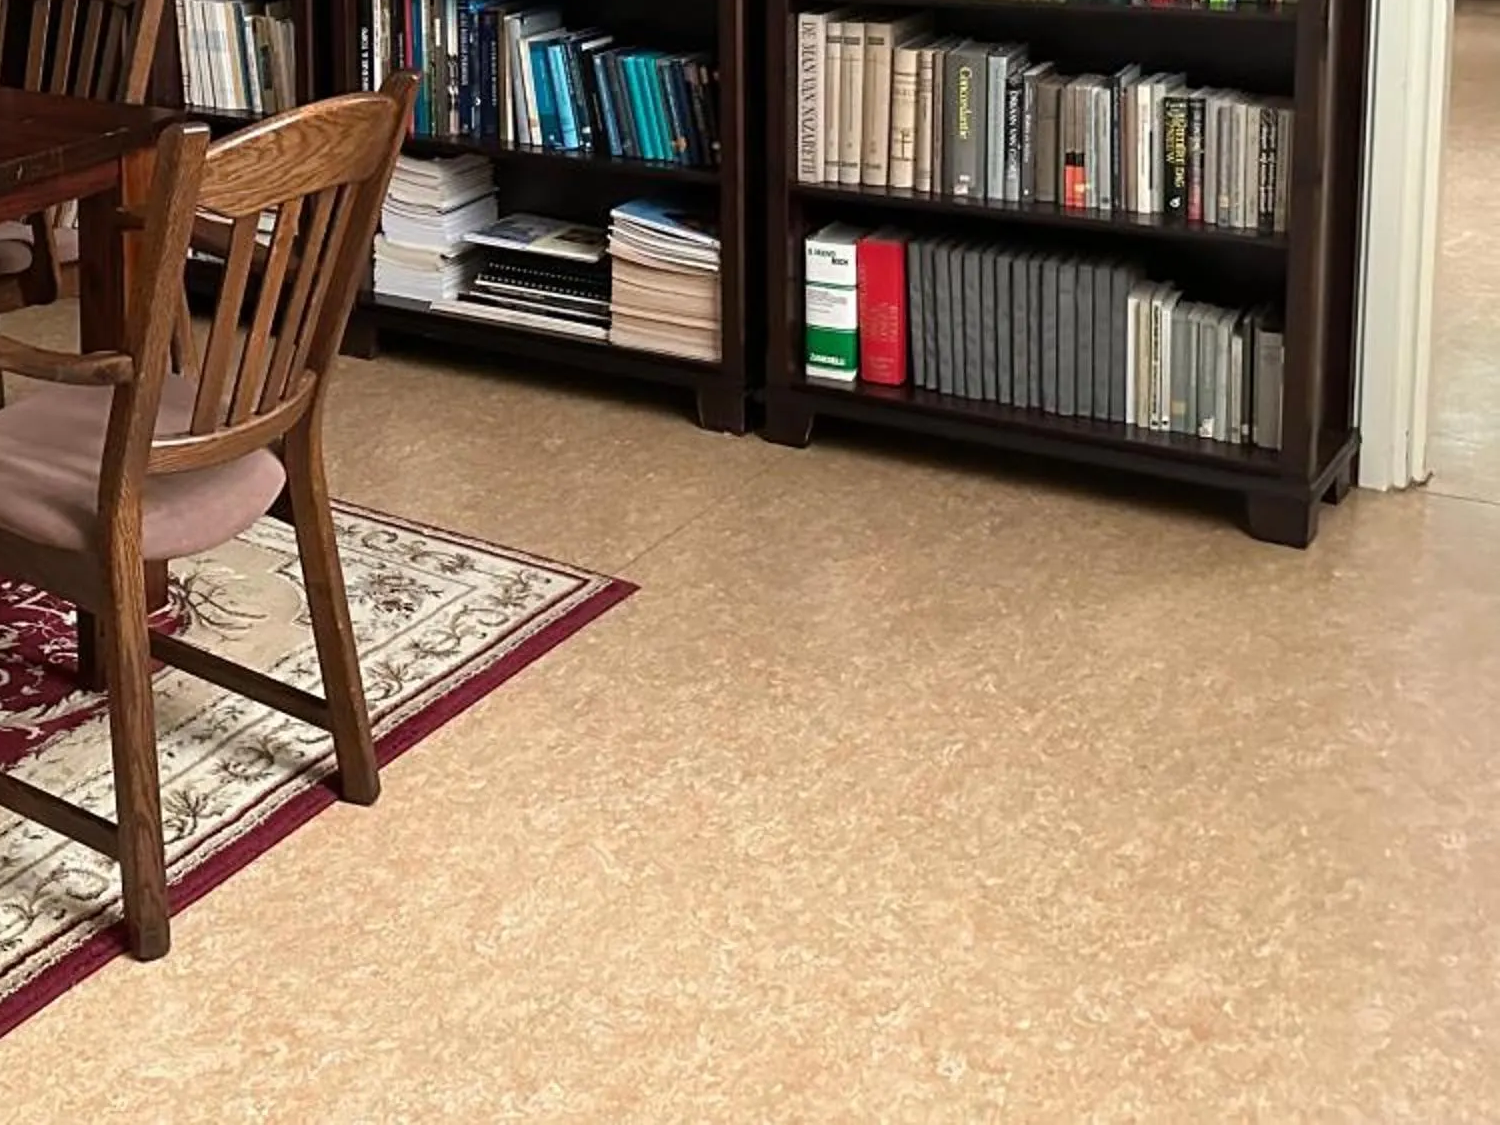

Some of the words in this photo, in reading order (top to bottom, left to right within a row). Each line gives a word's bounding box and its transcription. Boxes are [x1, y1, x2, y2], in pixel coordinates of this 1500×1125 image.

[802, 21, 817, 38] DE
[802, 42, 818, 73] MAN
[802, 76, 818, 102] VAN
[802, 105, 818, 175] NAZARETH
